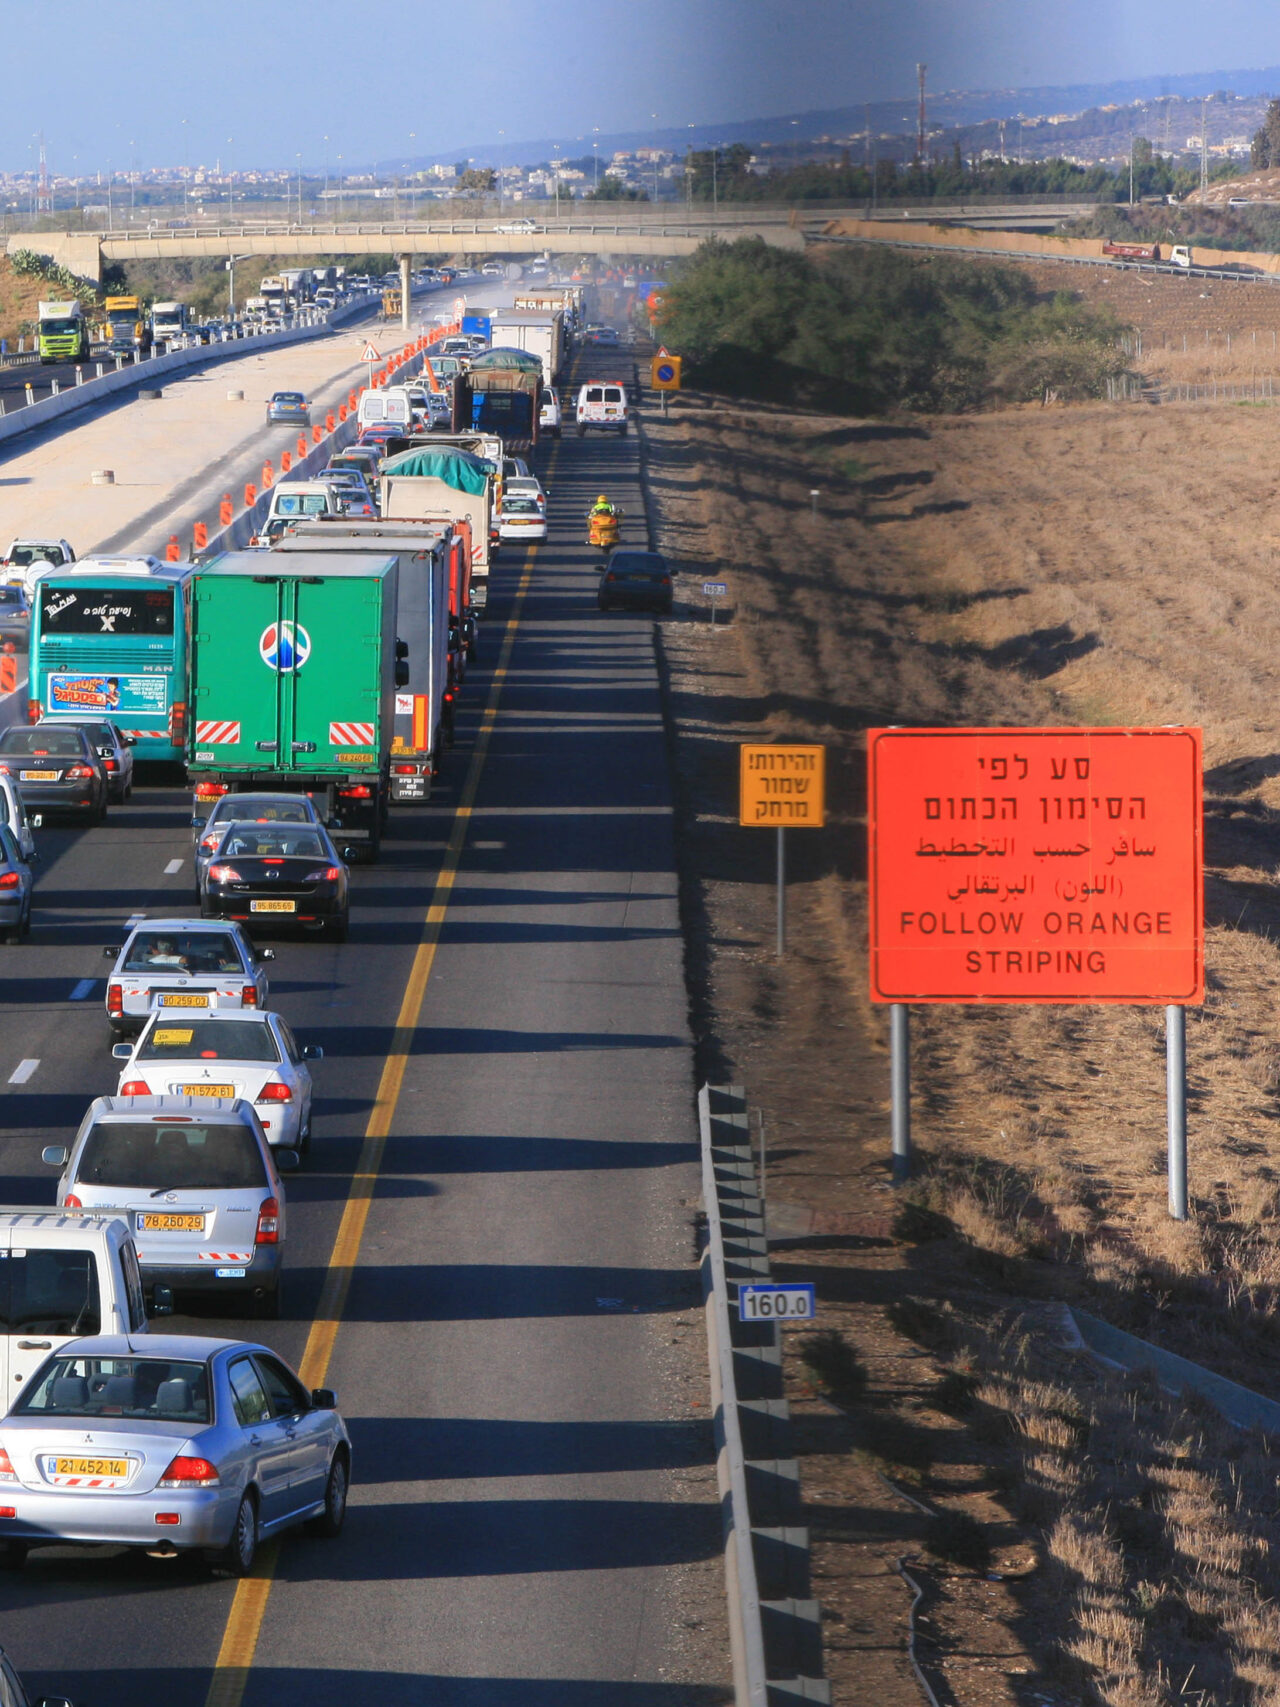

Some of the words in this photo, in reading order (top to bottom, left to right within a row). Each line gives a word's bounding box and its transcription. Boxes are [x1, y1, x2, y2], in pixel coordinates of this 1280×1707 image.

[749, 754, 816, 770] זהירות!
[977, 754, 1029, 781] לפי
[1050, 757, 1091, 780] סע
[760, 777, 810, 794] שמור
[756, 801, 808, 820] מרחק
[924, 797, 1018, 820] הכתום
[1039, 797, 1147, 824] הסימון
[915, 837, 1015, 863] التخطيط
[1033, 843, 1091, 863] حسب
[1105, 837, 1156, 866] سافر
[900, 911, 1024, 935] FOLLOW
[1043, 911, 1172, 935] ORANGE
[966, 950, 1106, 974] STRIPING
[748, 1293, 807, 1316] 160.0
